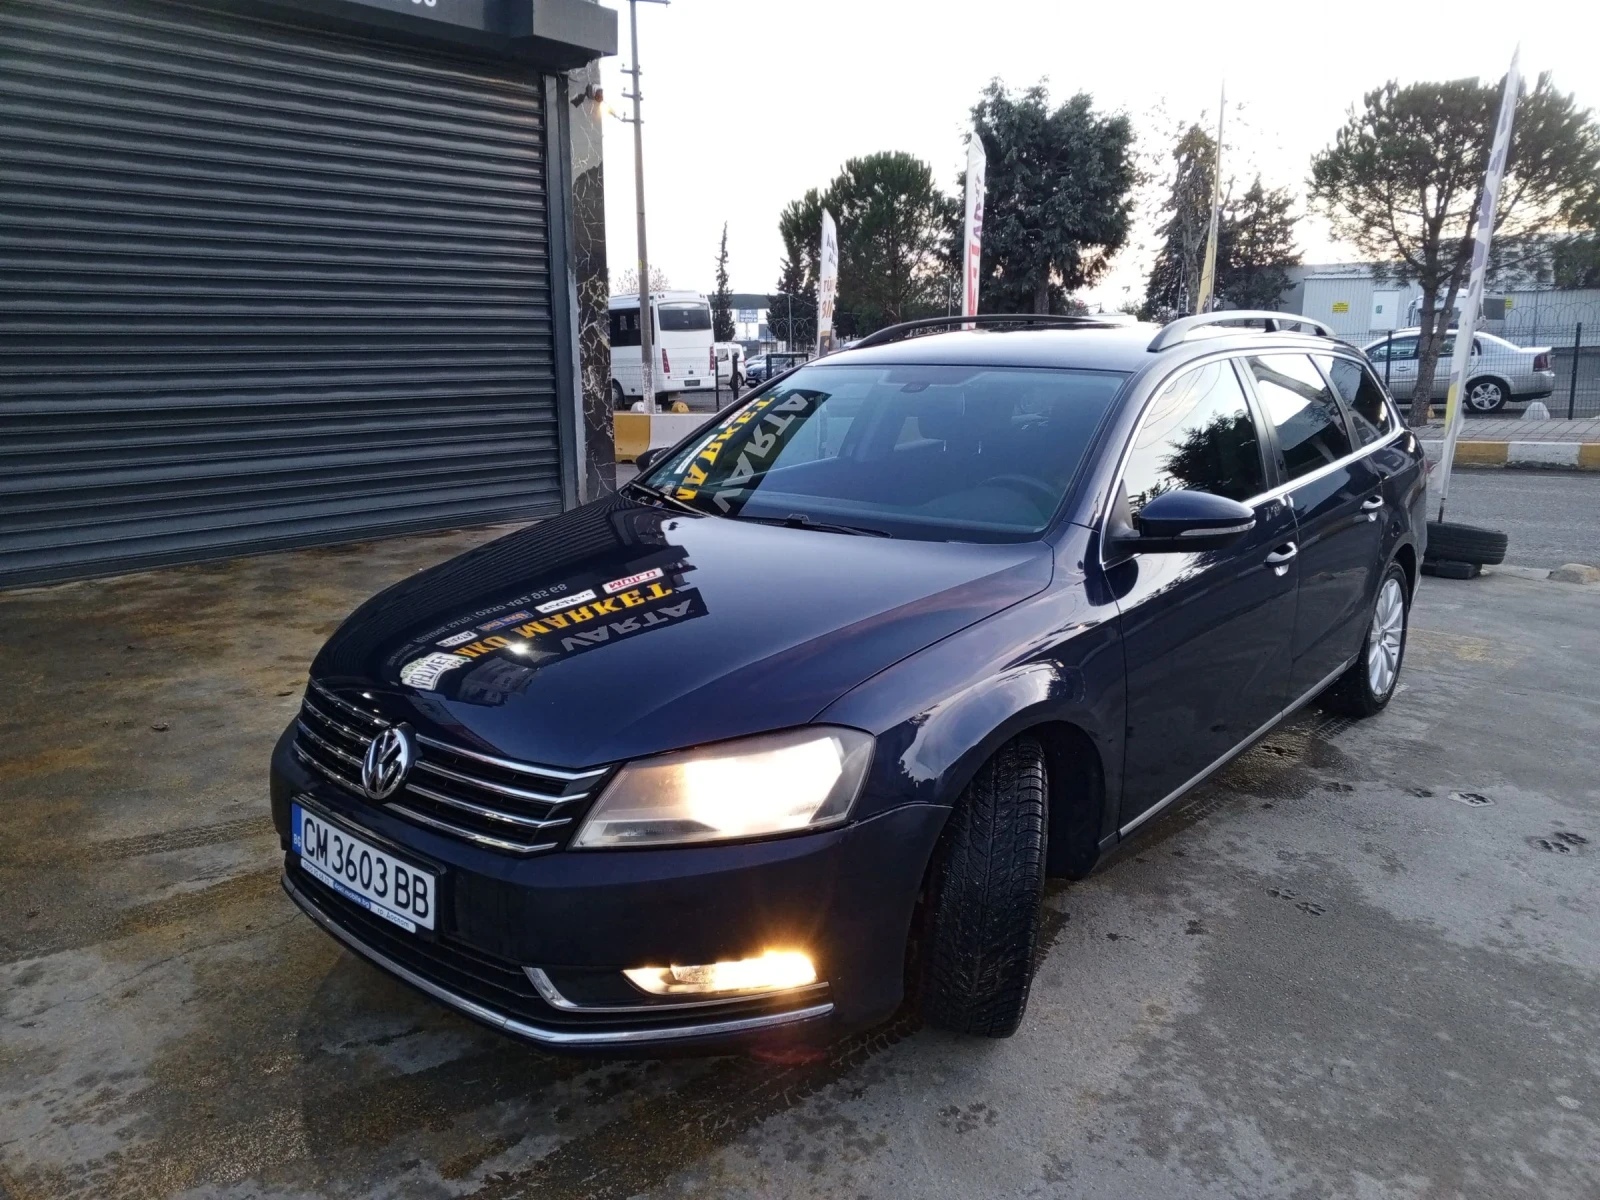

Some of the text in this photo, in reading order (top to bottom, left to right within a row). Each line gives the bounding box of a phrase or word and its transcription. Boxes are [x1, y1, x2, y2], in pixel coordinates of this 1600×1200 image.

[293, 833, 302, 847] BG
[304, 817, 328, 867] CM
[332, 835, 388, 898] 3603
[394, 865, 429, 919] BB
